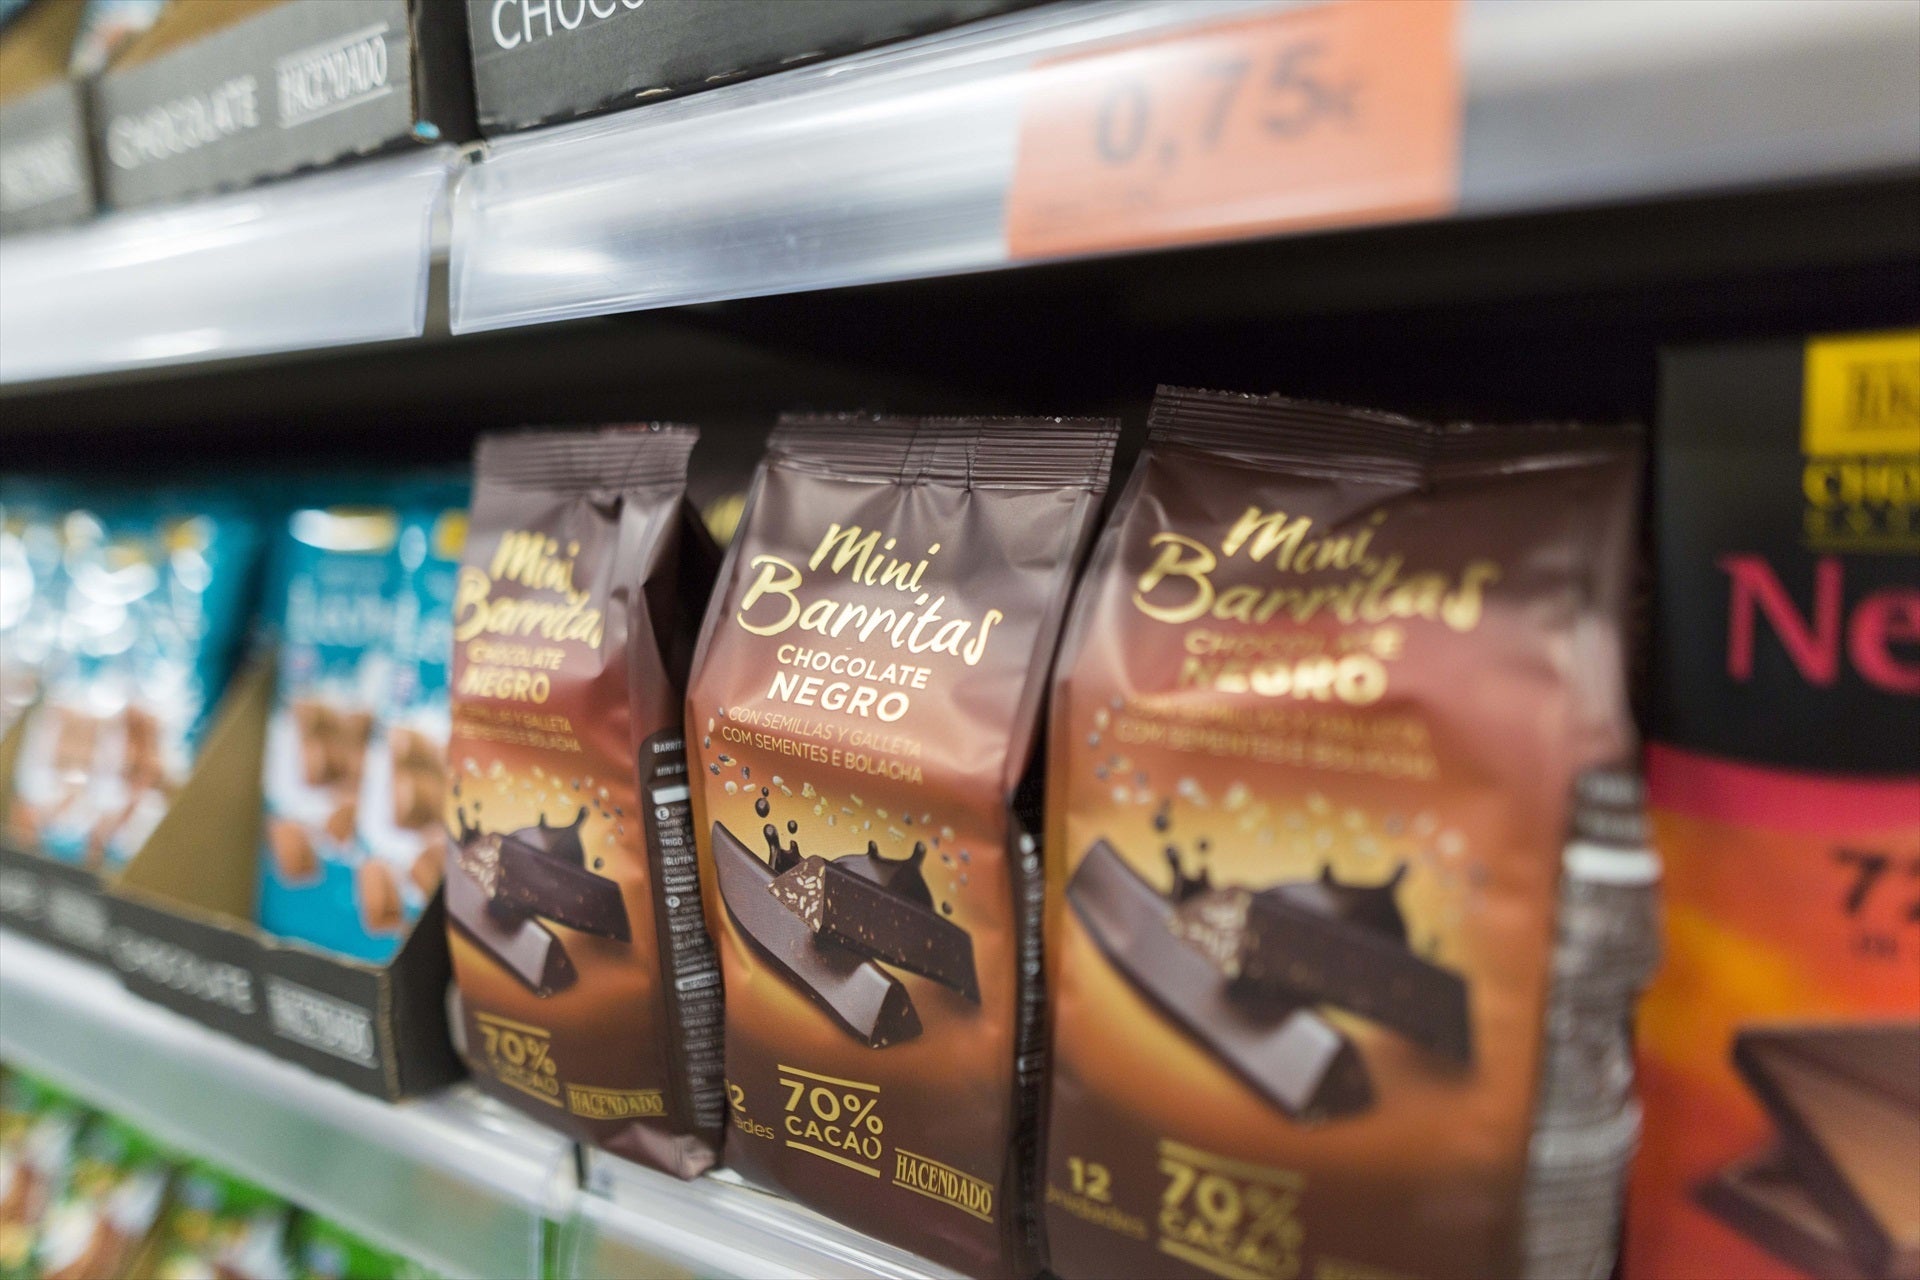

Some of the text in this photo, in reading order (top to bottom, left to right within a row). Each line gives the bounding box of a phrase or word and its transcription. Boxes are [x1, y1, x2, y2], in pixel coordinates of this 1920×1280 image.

[492, 0, 645, 49] CHO
[489, 529, 580, 595] Mini
[808, 522, 941, 593] Mini
[1221, 506, 1388, 573] Mini
[736, 553, 1003, 666] Barritas
[1133, 532, 1500, 633] Barritas
[466, 640, 566, 671] CHOCOLATE
[776, 644, 931, 690] CHOCOLATE
[457, 664, 550, 705] NEGRO
[766, 670, 910, 723] NEGRO
[722, 726, 923, 785] COM SEMENTES E BOLACHA
[728, 705, 922, 758] CON SEMILLAS Y GALLETA
[478, 1022, 557, 1077] 70%
[570, 1089, 663, 1116] HACENDADO
[779, 1078, 884, 1136] 70%
[785, 1116, 882, 1160] CACAO
[895, 1154, 993, 1215] HACENDADO
[1066, 1156, 1112, 1203] 12
[1157, 1157, 1305, 1250] 70%
